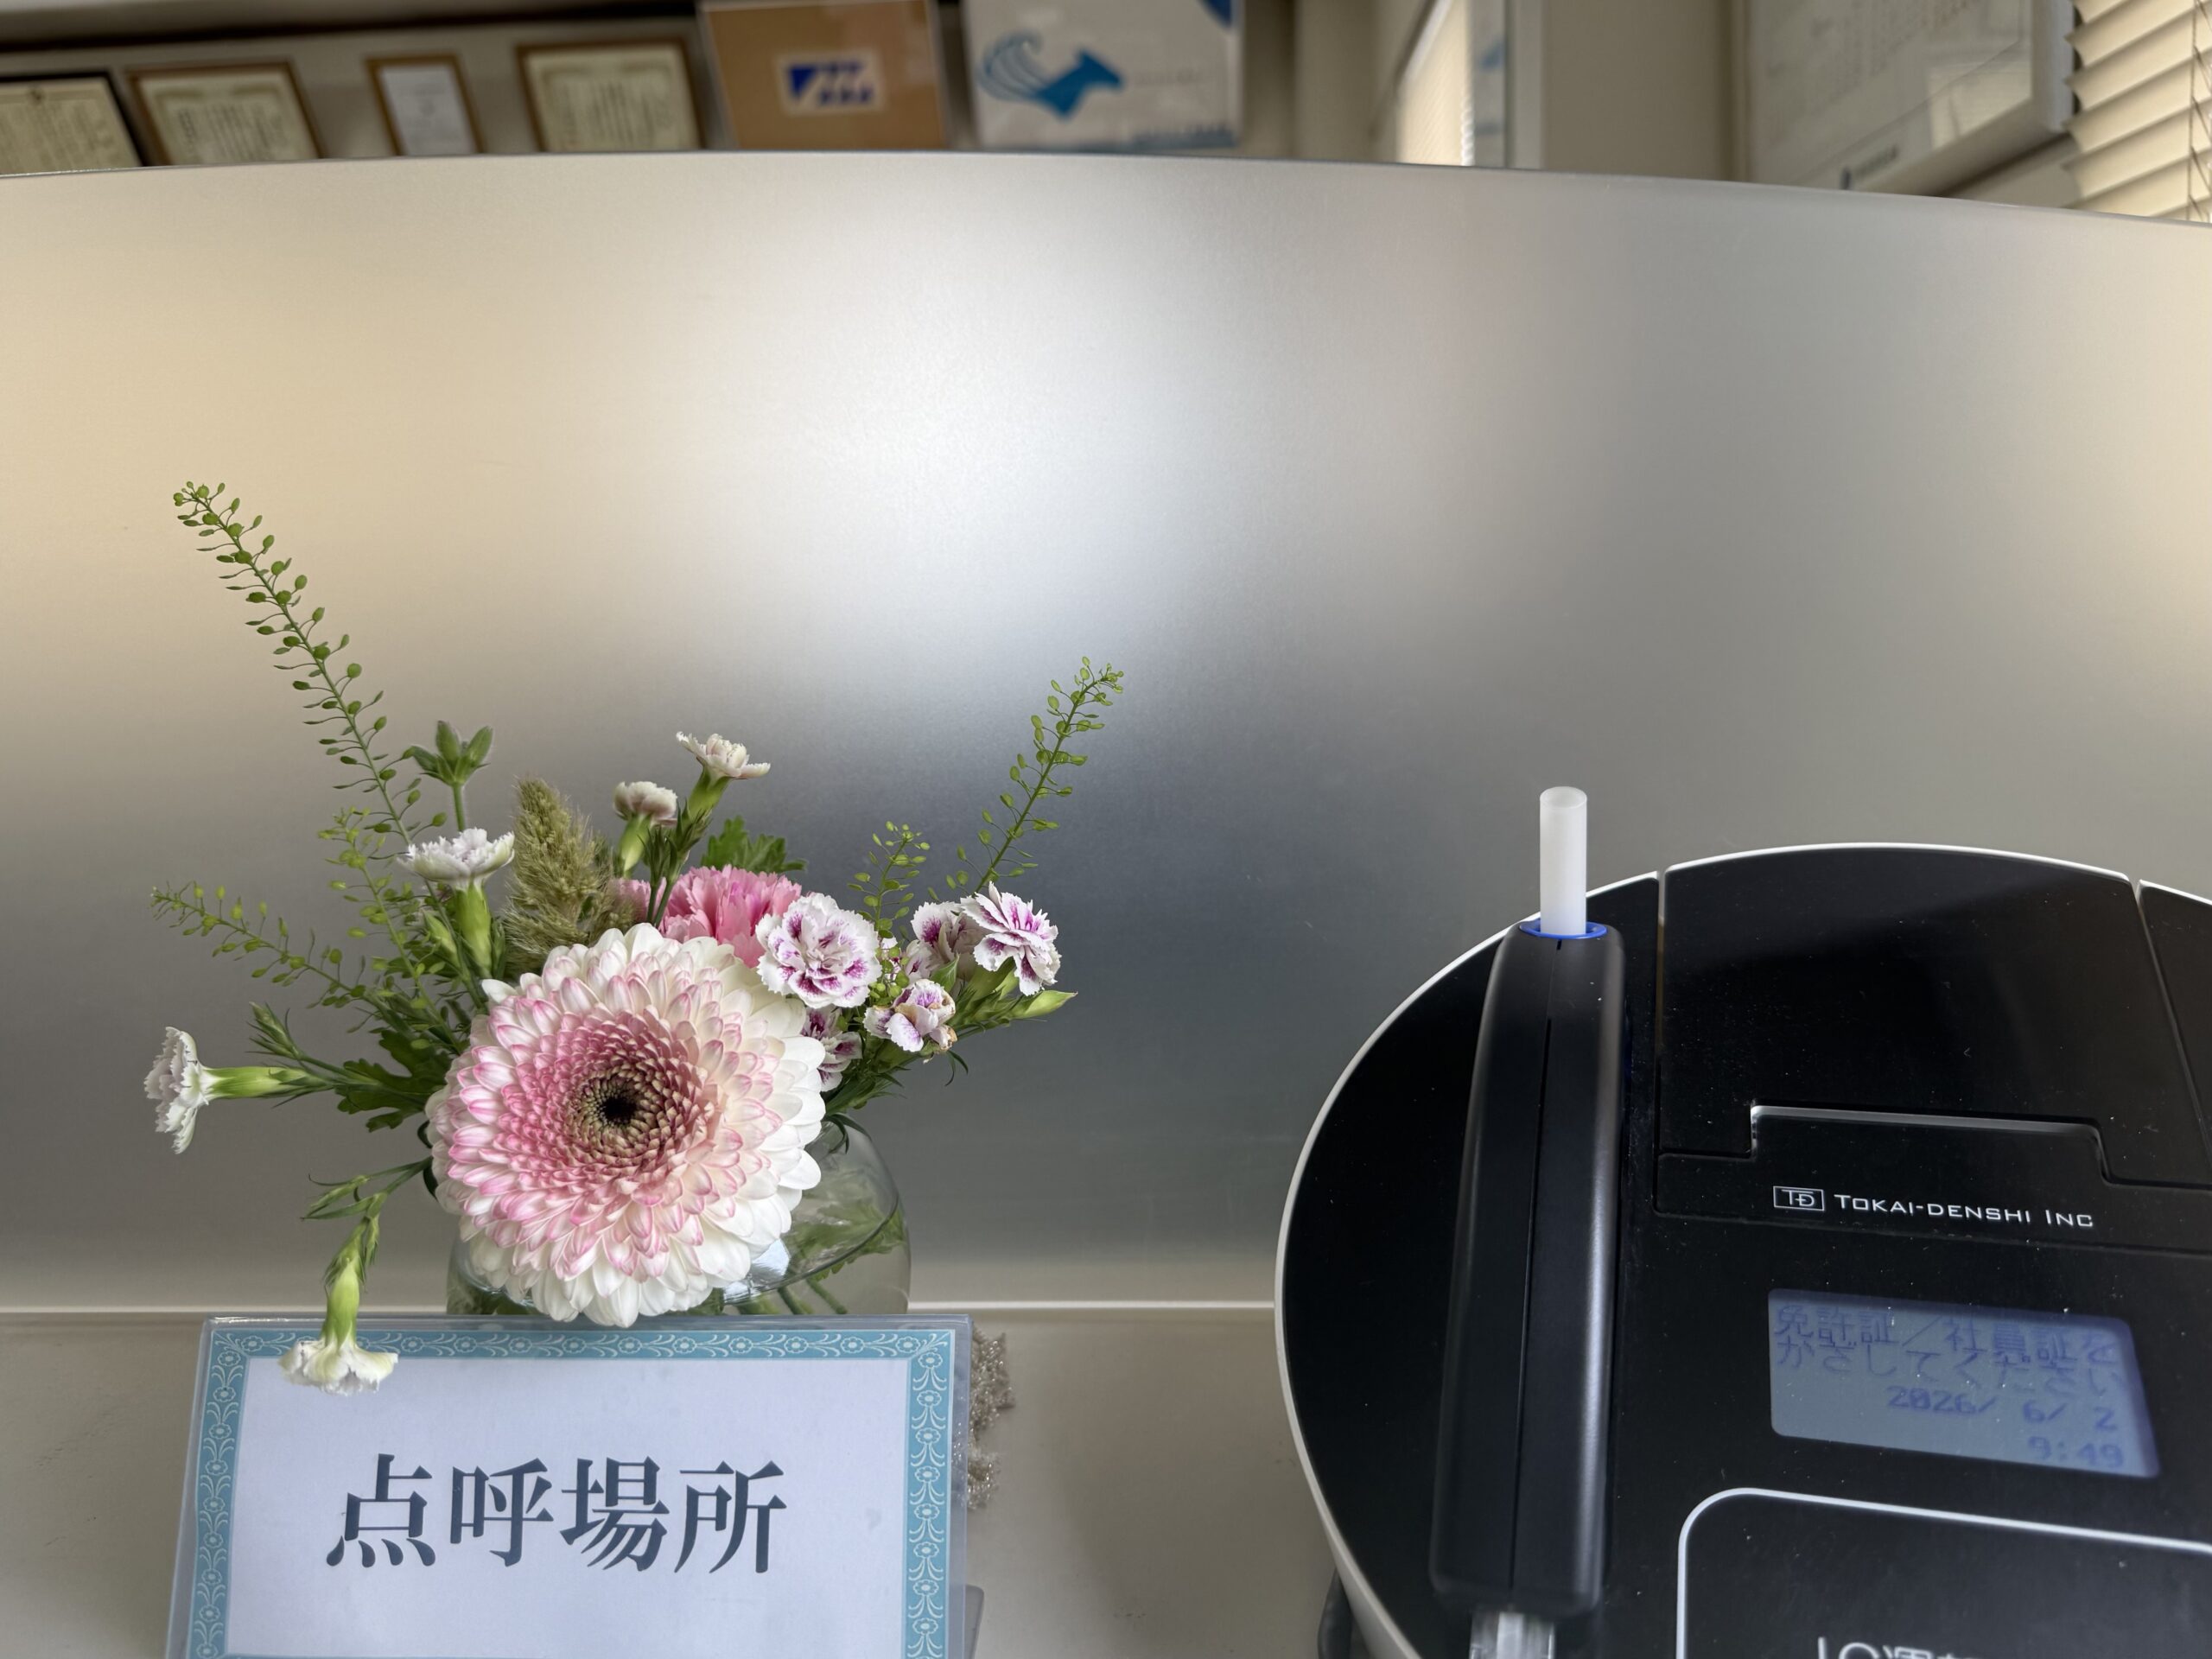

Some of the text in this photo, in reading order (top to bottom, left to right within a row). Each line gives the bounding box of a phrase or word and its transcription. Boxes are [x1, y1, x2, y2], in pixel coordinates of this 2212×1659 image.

[1834, 1193, 2031, 1224] TOKAI-DENSHI
[2044, 1209, 2094, 1229] INC
[325, 1452, 788, 1574] 点呼場所
